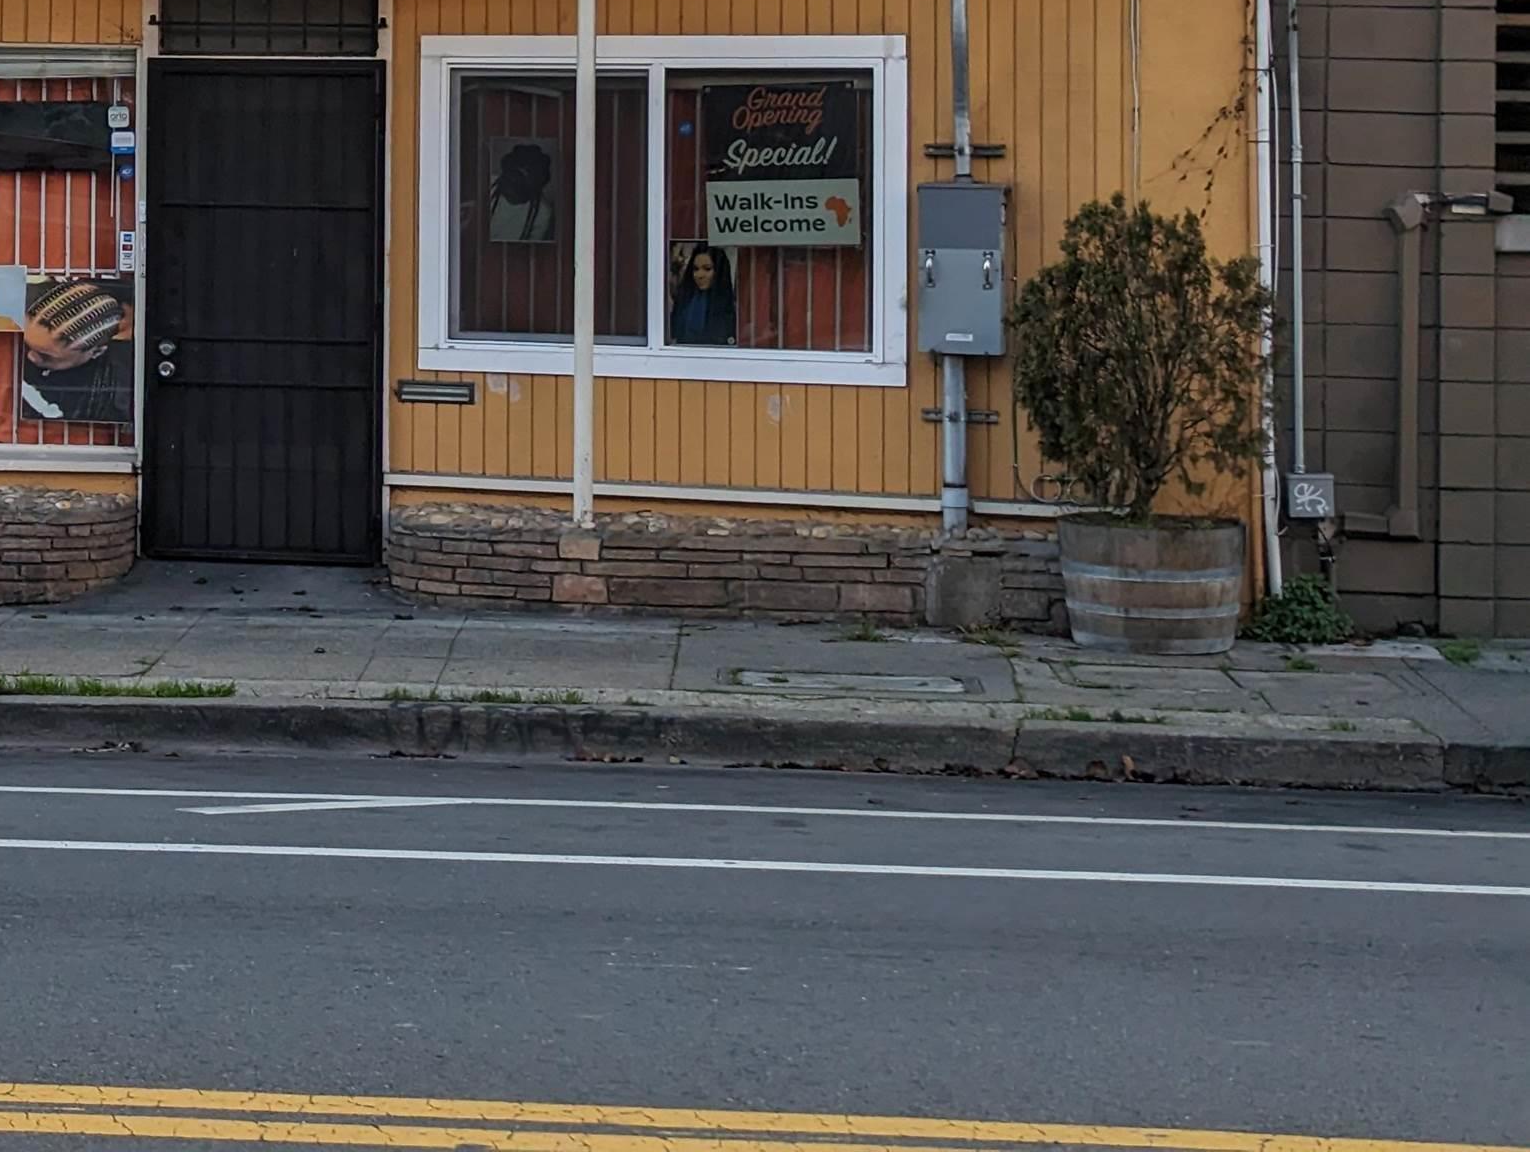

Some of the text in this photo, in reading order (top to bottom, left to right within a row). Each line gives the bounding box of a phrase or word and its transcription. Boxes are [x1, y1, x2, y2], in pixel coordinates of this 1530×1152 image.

[748, 86, 827, 108] Grand
[732, 106, 822, 135] Opening
[722, 136, 837, 175] Special!
[713, 193, 818, 210] Walk-Ins
[714, 215, 826, 233] Welcome
